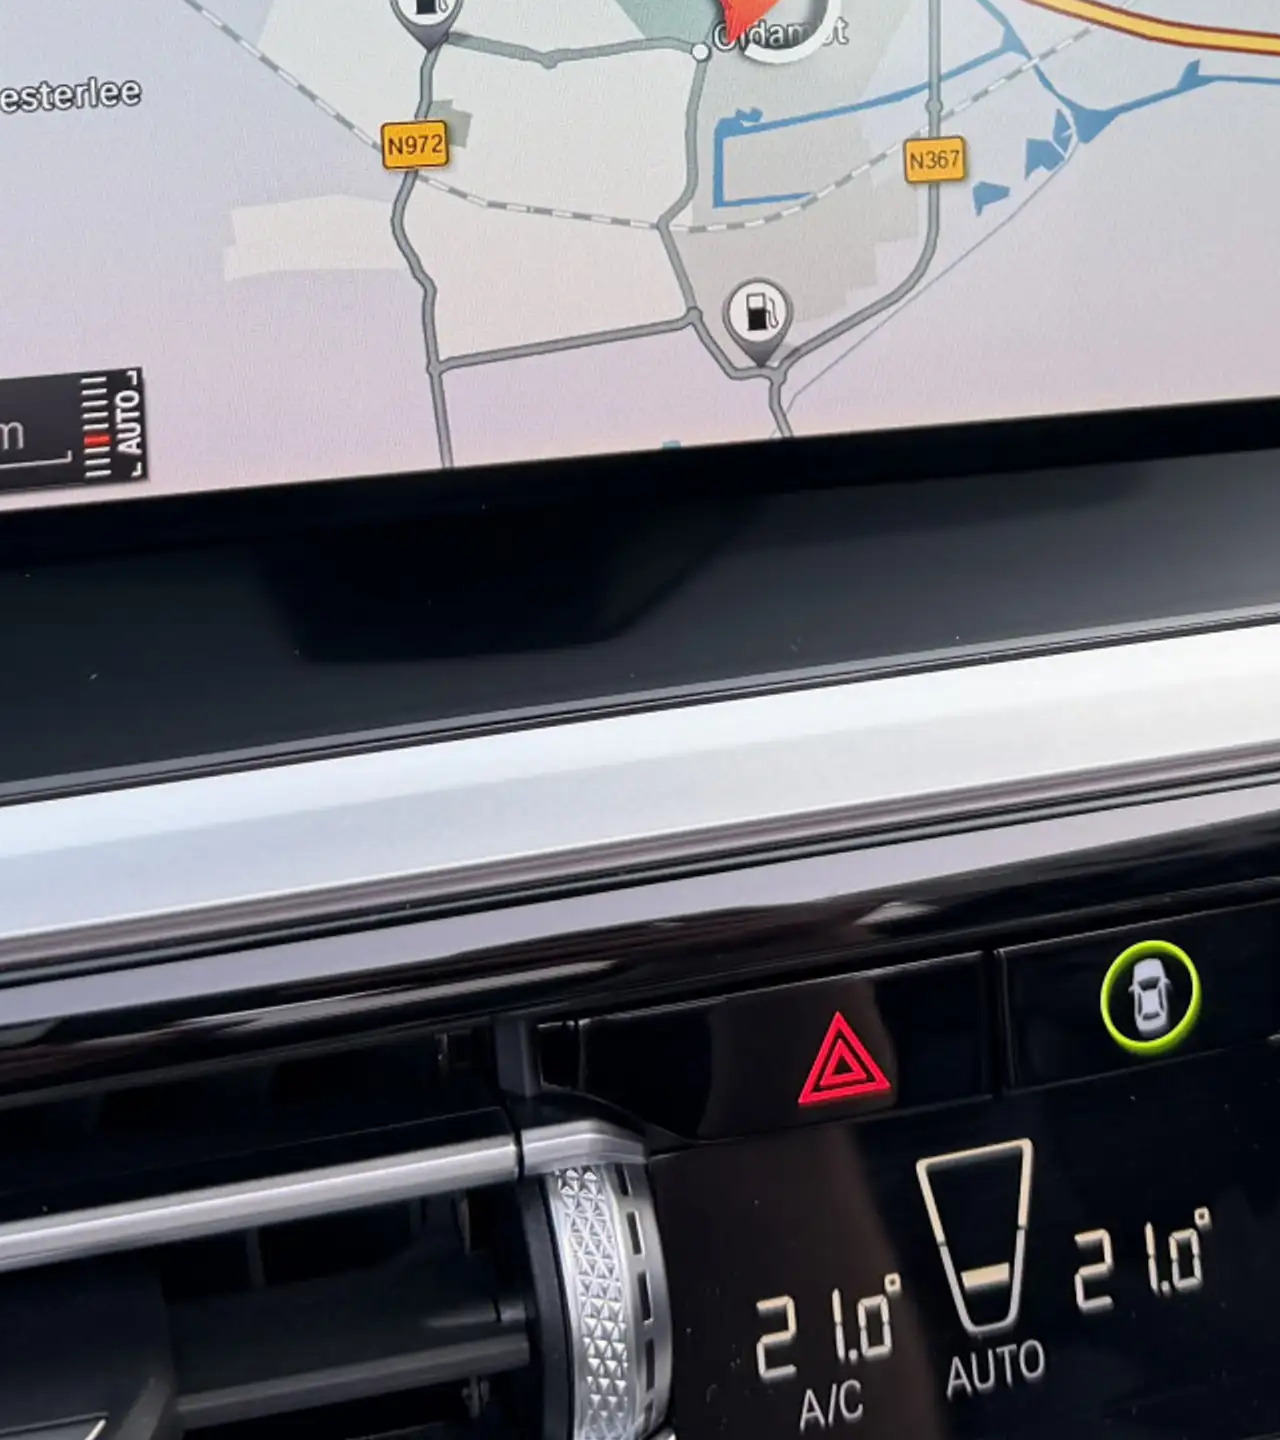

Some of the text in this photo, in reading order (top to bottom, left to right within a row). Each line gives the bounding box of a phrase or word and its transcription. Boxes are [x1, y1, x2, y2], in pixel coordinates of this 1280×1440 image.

[712, 15, 850, 51] Oldamt
[388, 134, 444, 156] N972
[909, 150, 961, 171] N367
[115, 388, 143, 456] AUTO
[947, 1339, 1046, 1398] AUTO
[799, 1380, 864, 1430] A/C
